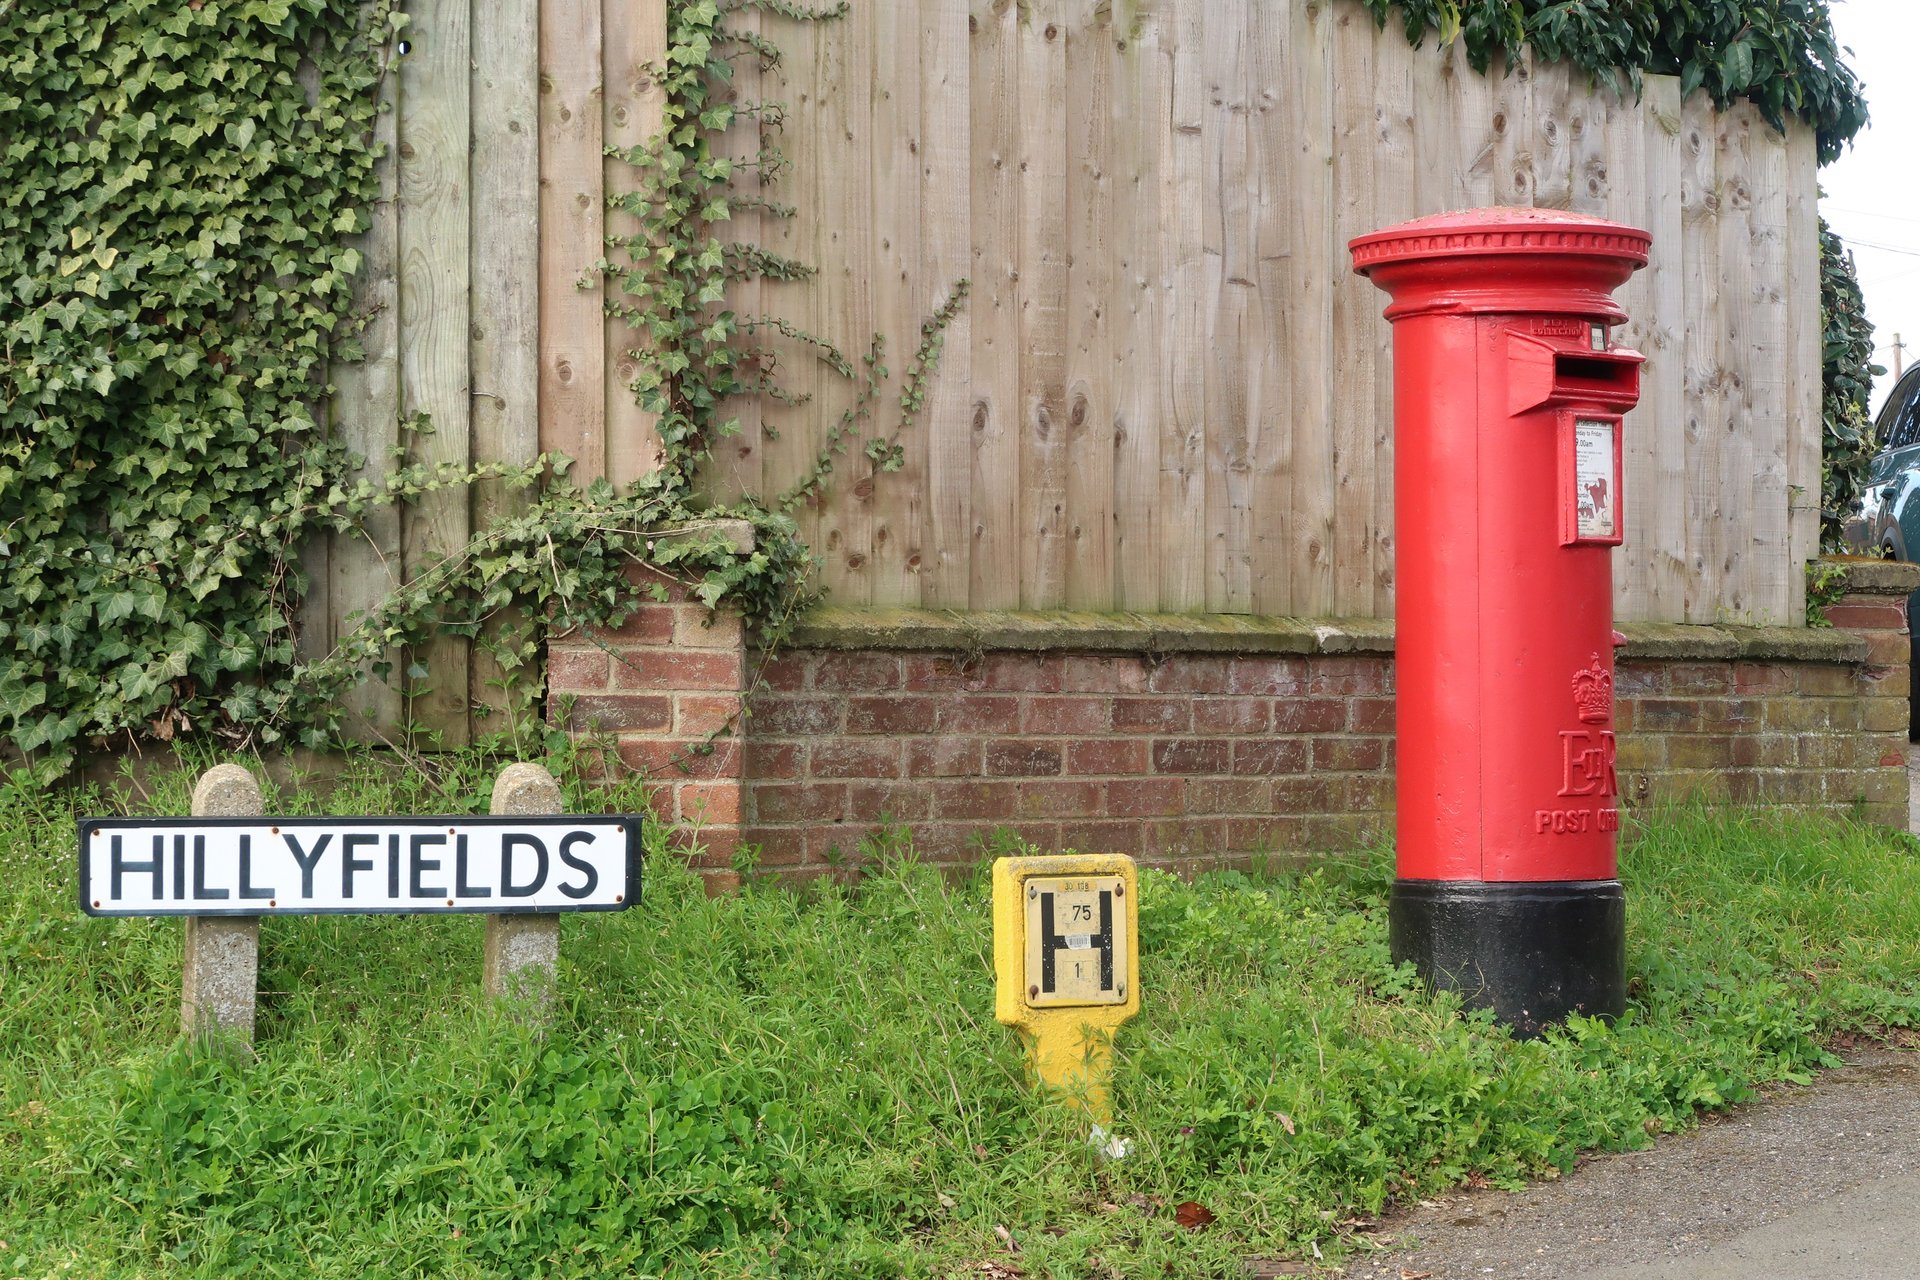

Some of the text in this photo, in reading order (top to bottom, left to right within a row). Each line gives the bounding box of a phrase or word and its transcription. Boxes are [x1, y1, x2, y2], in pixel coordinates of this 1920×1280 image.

[1535, 809, 1590, 834] POST
[110, 830, 598, 900] HILLYFIELDS
[1072, 905, 1092, 921] 75
[1041, 891, 1113, 993] H
[1074, 962, 1081, 978] 1
